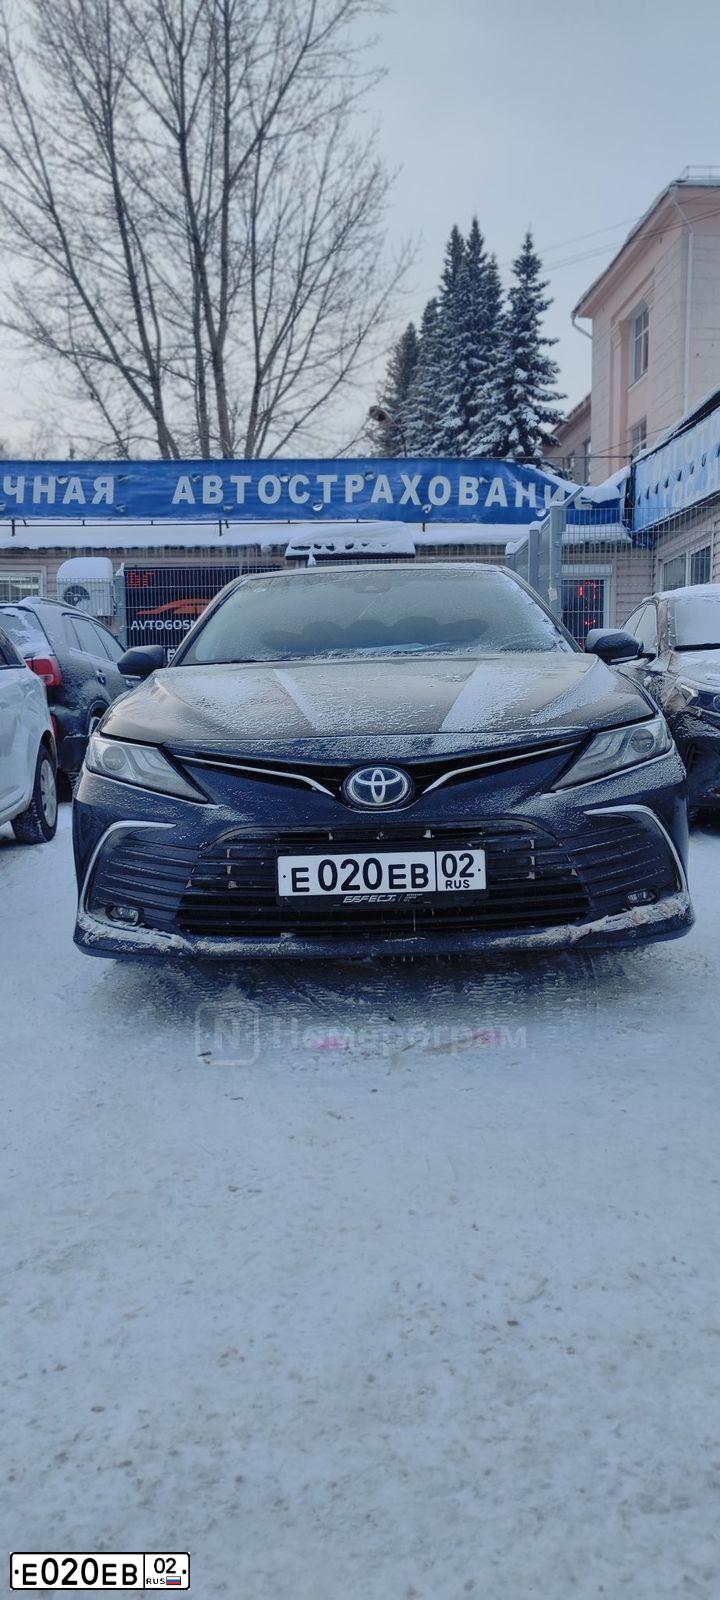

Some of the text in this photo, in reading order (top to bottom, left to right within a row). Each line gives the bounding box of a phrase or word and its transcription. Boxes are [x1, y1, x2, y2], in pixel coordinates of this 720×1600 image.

[2, 475, 115, 505] ЧНАЯ
[441, 853, 475, 879] 02
[445, 879, 470, 890] RUS
